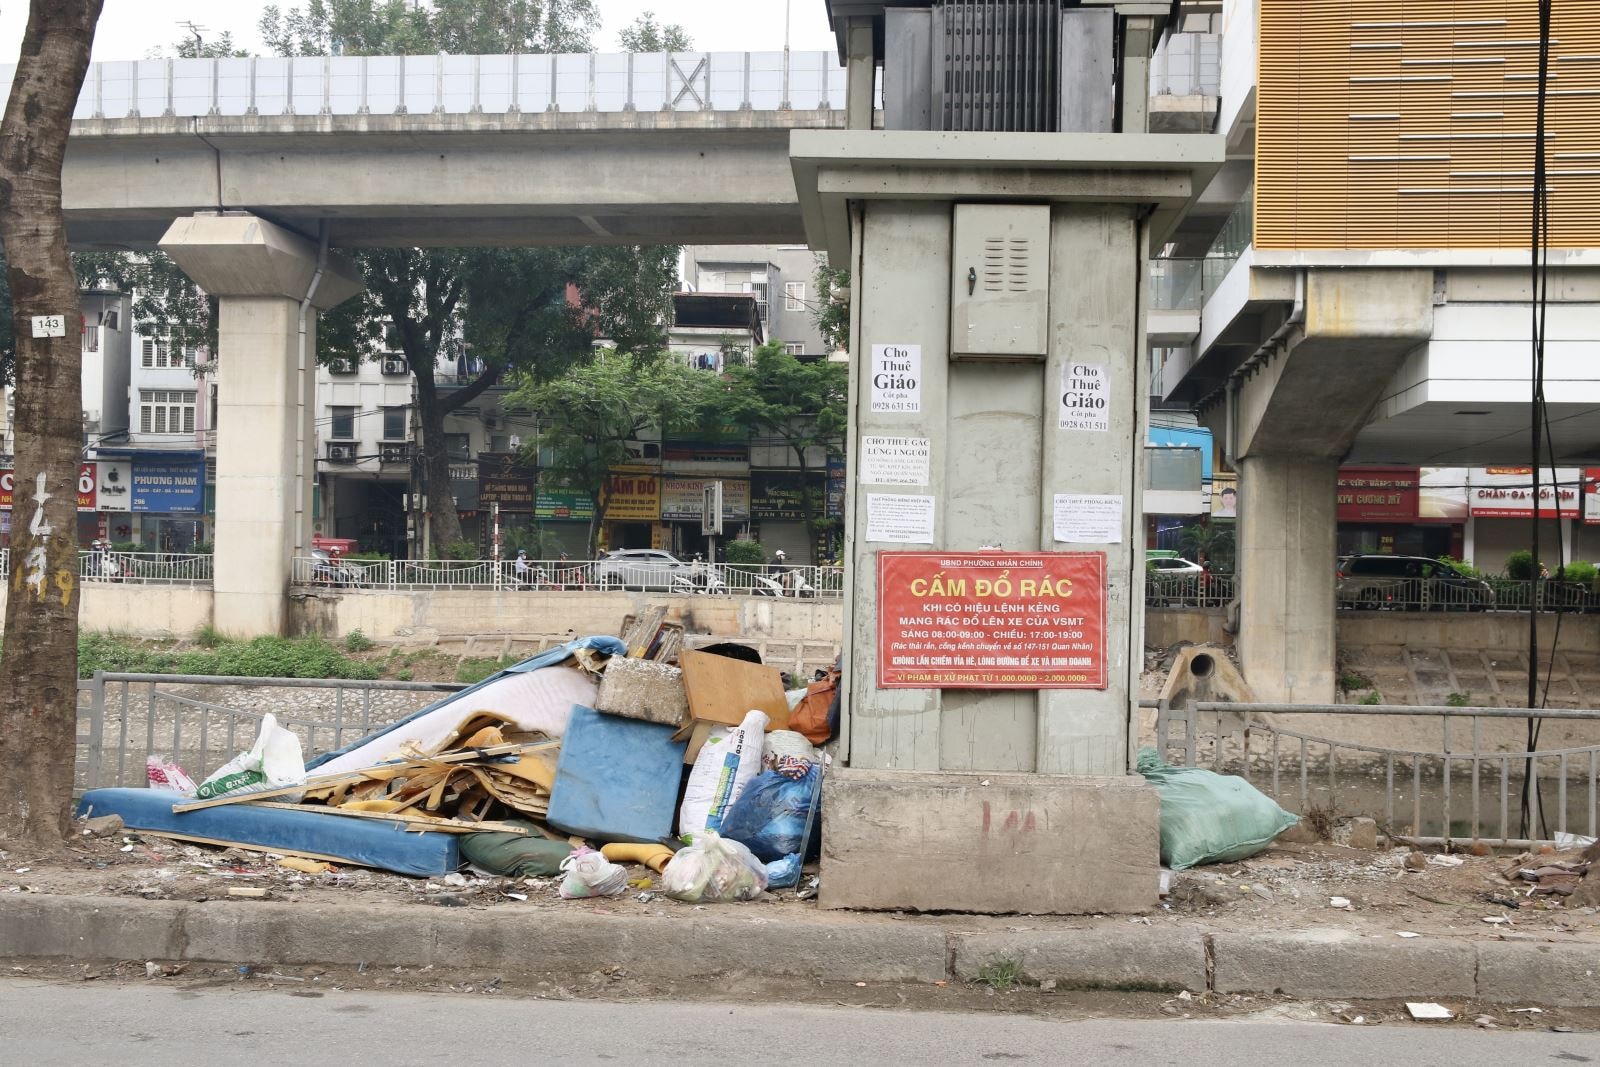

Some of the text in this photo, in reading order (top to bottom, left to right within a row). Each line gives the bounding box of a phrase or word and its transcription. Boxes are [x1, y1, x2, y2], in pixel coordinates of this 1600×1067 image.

[38, 319, 59, 328] 143
[884, 347, 908, 358] Cho
[881, 360, 911, 371] Thuê
[1073, 365, 1098, 377] Cho
[873, 373, 916, 390] Giáo
[1070, 378, 1101, 390] Thuê
[1062, 391, 1105, 409] Giáo
[872, 402, 890, 410] 0928
[1060, 420, 1107, 430] 0928 631 511
[174, 477, 198, 486] NAM
[940, 558, 1043, 567] UBND PHƯỜNG NHÂN CHÍNH
[910, 569, 1073, 598] CẤM ĐỔ RÁC
[922, 603, 942, 612] KHI
[945, 602, 962, 612] CÓ
[964, 602, 991, 614] HIỆU
[994, 602, 1025, 614] LỆNH
[899, 613, 1084, 626] MANG RÁC ĐỔ LÊN XE CỦA VSMT
[901, 629, 929, 638] SÁNG
[931, 630, 985, 639] 08:00-09:00
[1029, 631, 1083, 639] 17:00-19:00
[1051, 643, 1070, 651] Quan
[892, 654, 915, 665] KHÔNG
[1030, 657, 1040, 666] XE
[1041, 655, 1050, 666] VÀ
[1051, 657, 1067, 666] KINH
[1068, 657, 1092, 666] DOANH
[907, 674, 931, 682] PHẠM
[933, 674, 942, 682] BỊ
[957, 674, 980, 683] PHẠT
[994, 674, 1037, 682] 1.000.000Đ
[1044, 674, 1087, 682] 2.000.000Đ
